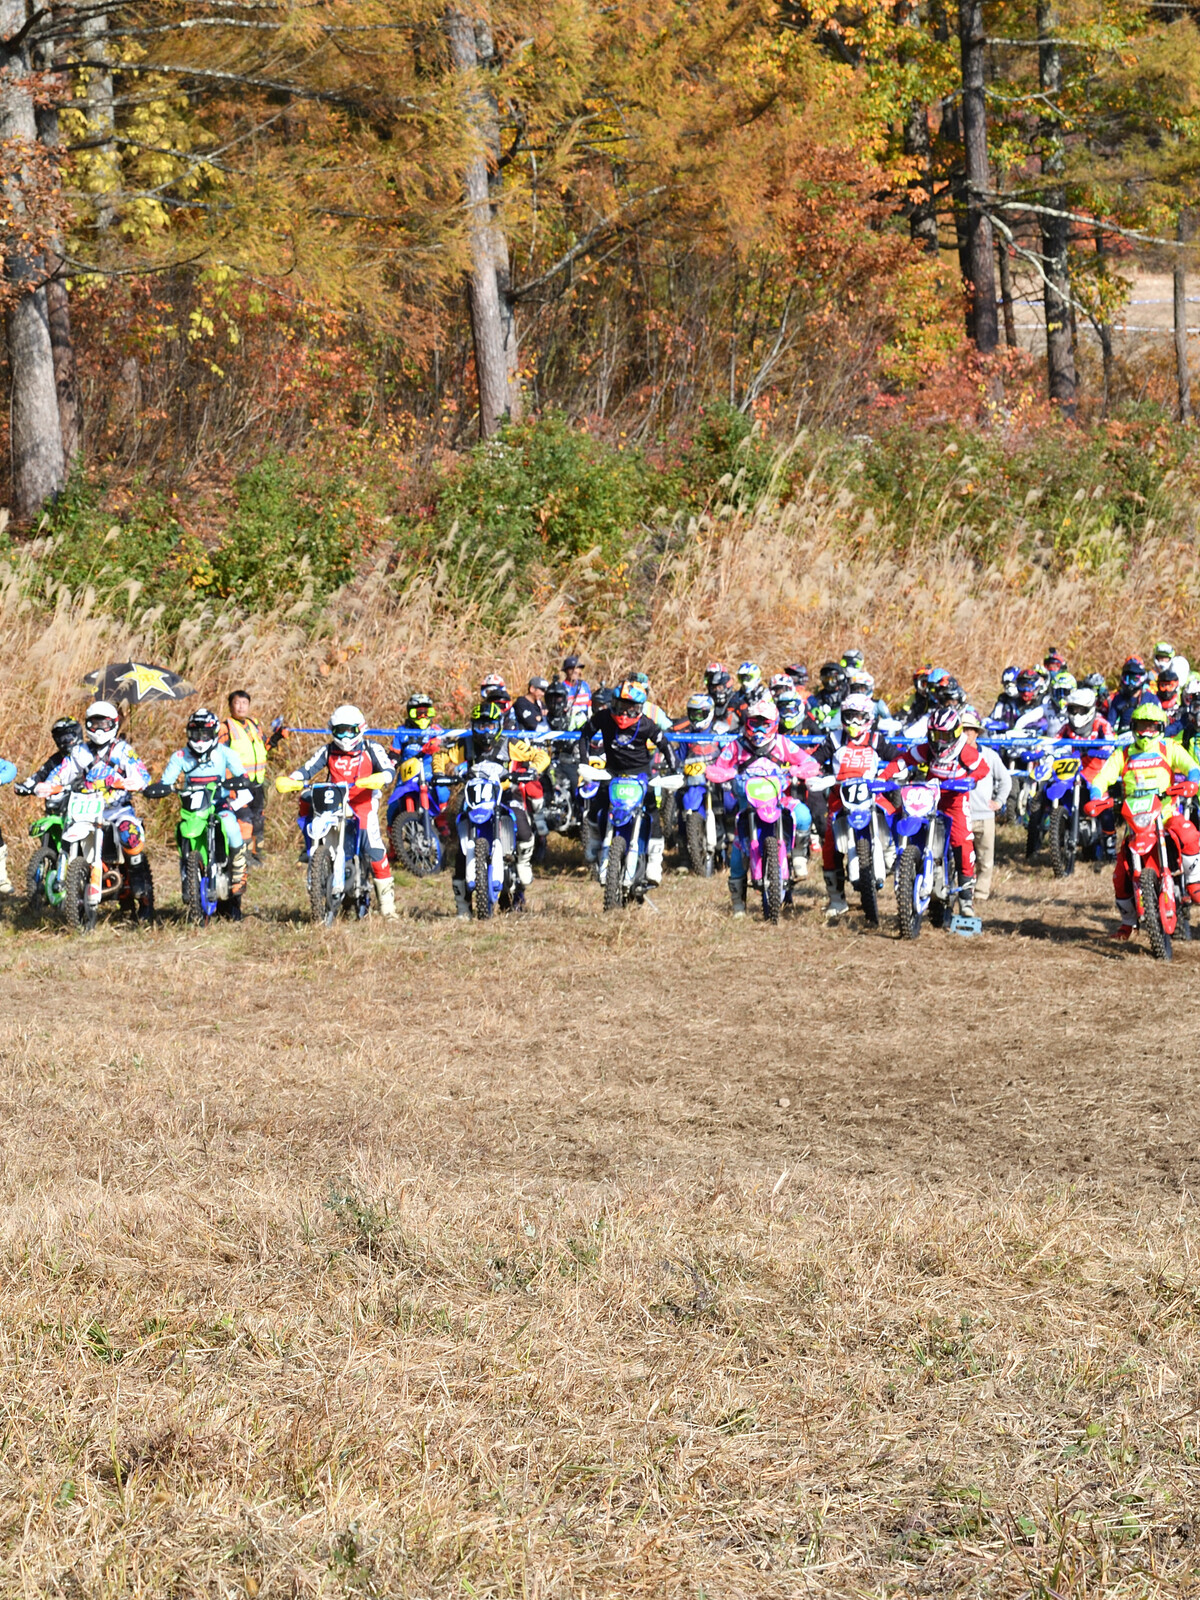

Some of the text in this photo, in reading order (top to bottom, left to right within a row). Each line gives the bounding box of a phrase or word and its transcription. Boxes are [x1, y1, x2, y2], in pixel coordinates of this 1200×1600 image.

[1055, 761, 1079, 775] 20
[190, 790, 204, 810] 1
[323, 790, 333, 804] 2
[474, 783, 492, 803] 14
[848, 783, 869, 803] 13
